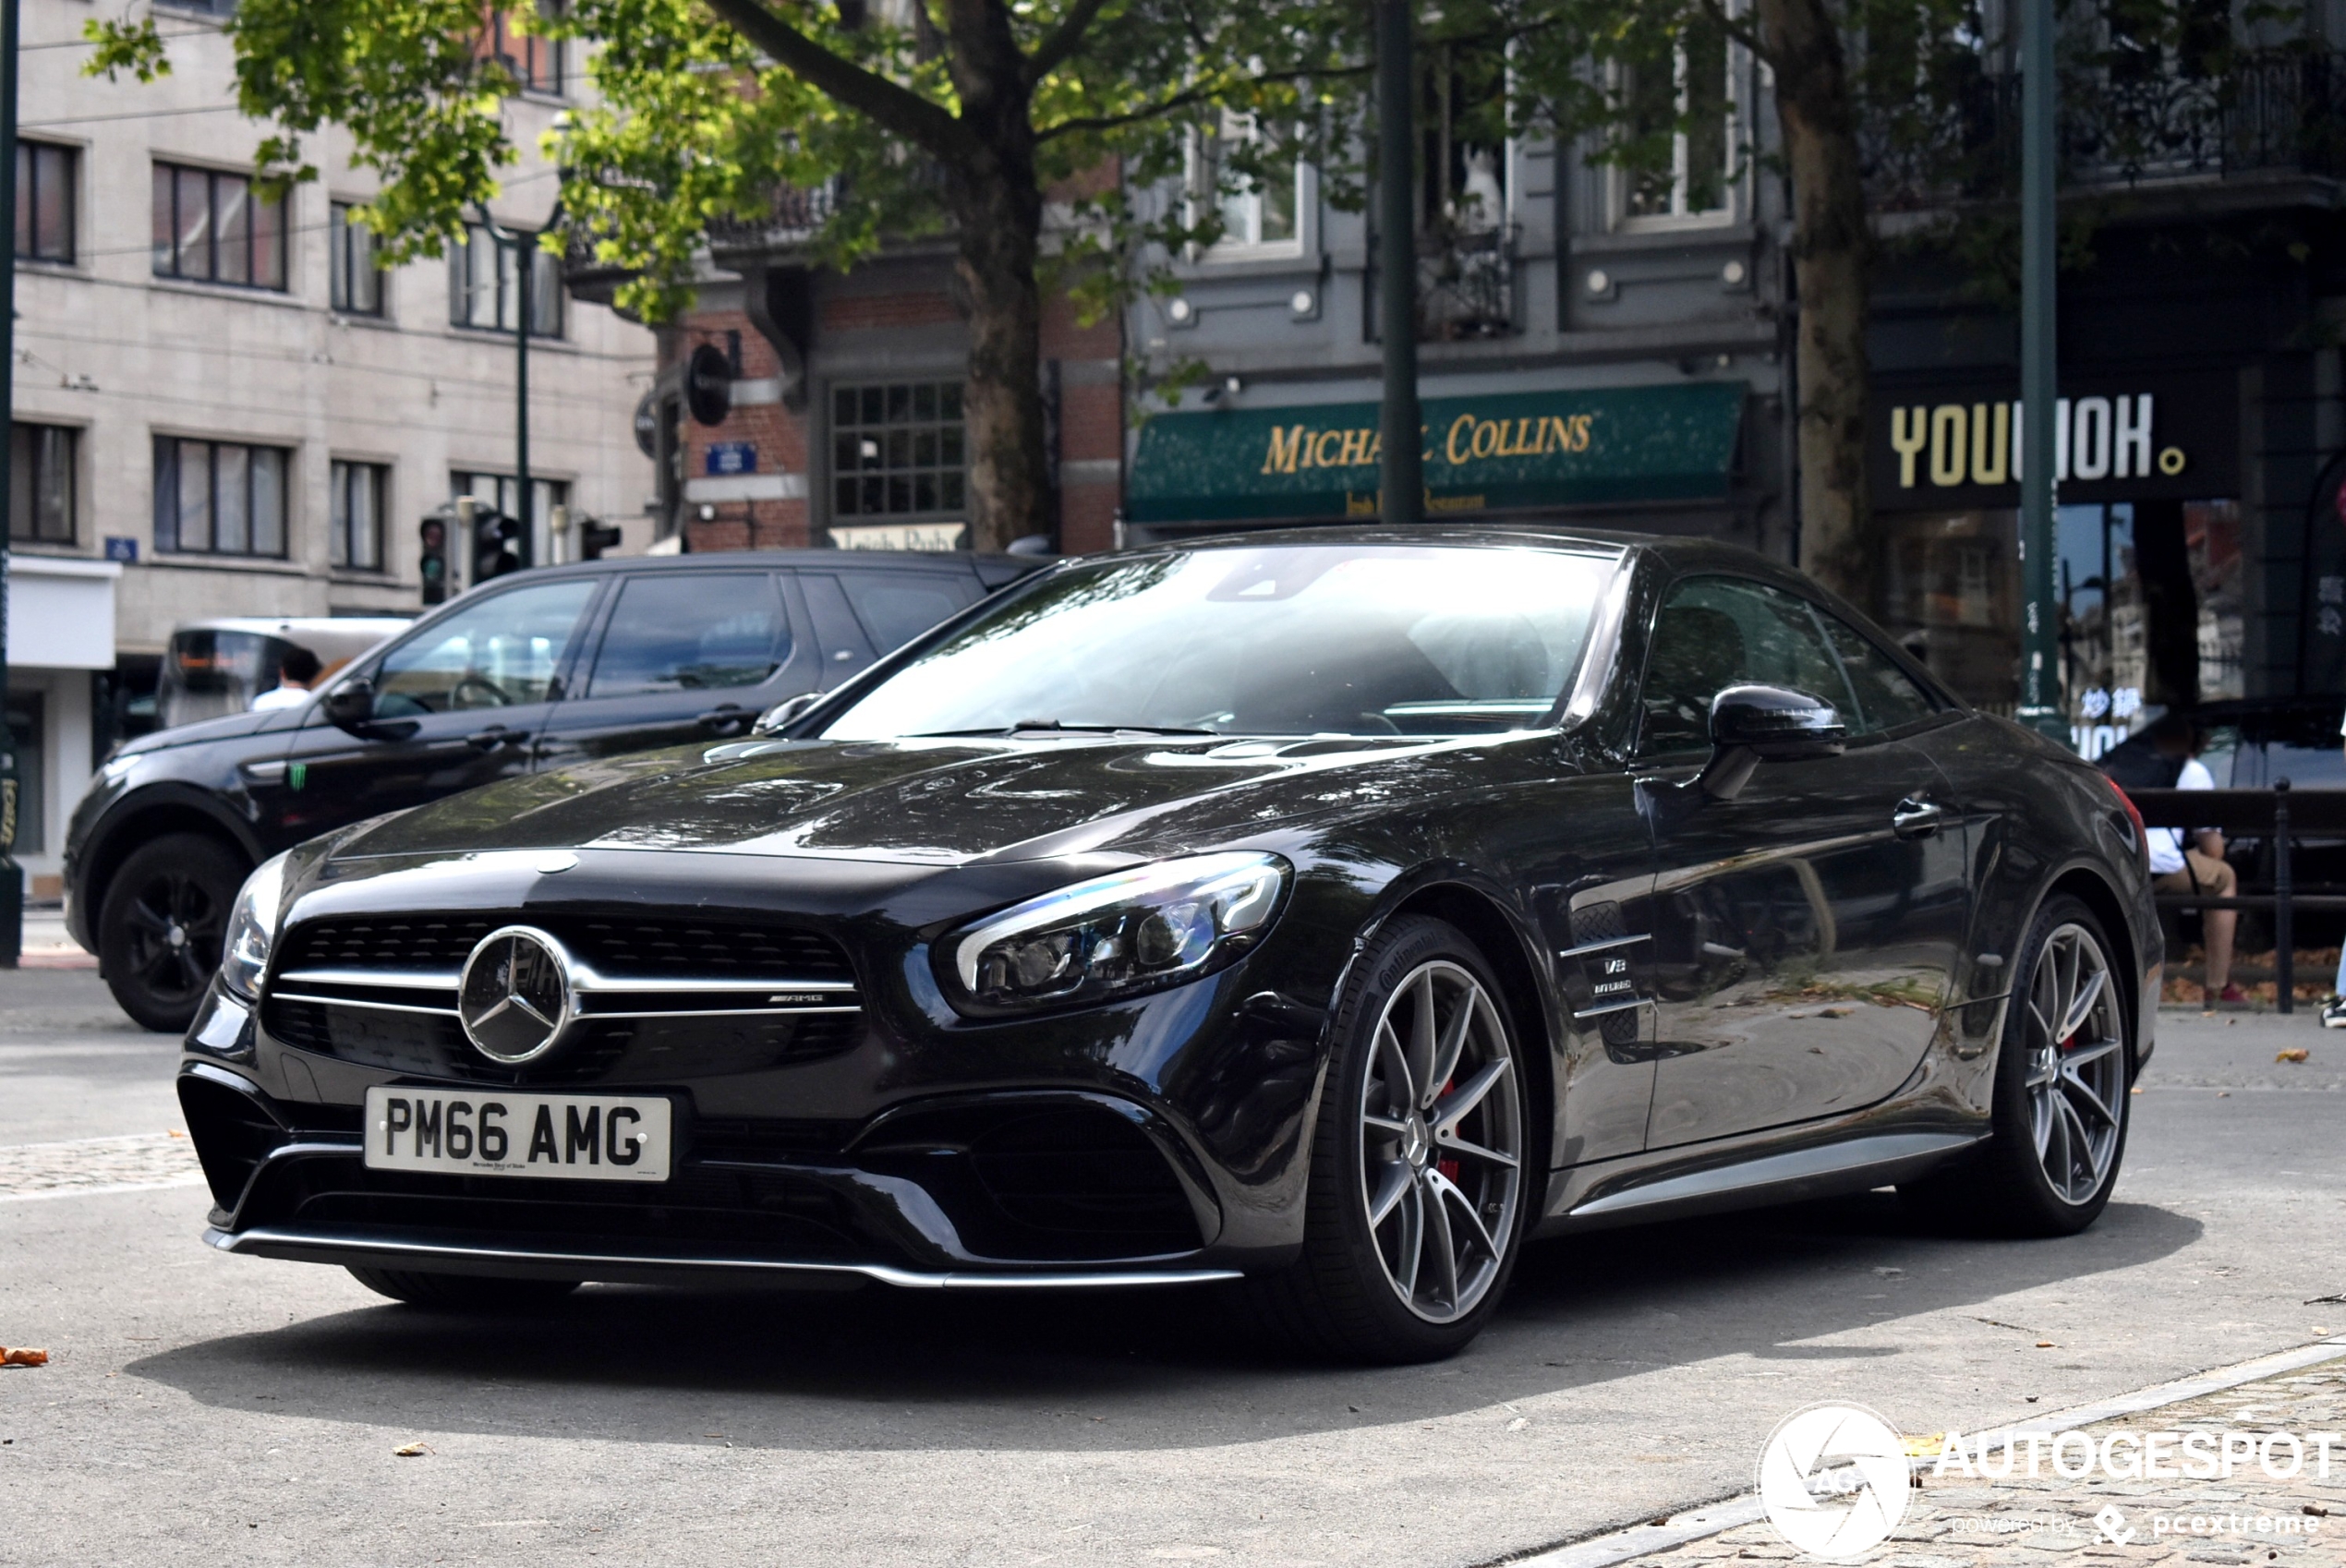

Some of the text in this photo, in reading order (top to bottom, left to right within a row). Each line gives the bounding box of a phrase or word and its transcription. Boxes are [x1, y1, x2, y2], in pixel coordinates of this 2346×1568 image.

[1261, 413, 1592, 475] MICHA COLLINS
[1604, 959, 1626, 975] V8
[386, 1098, 642, 1166] PM66 AMG
